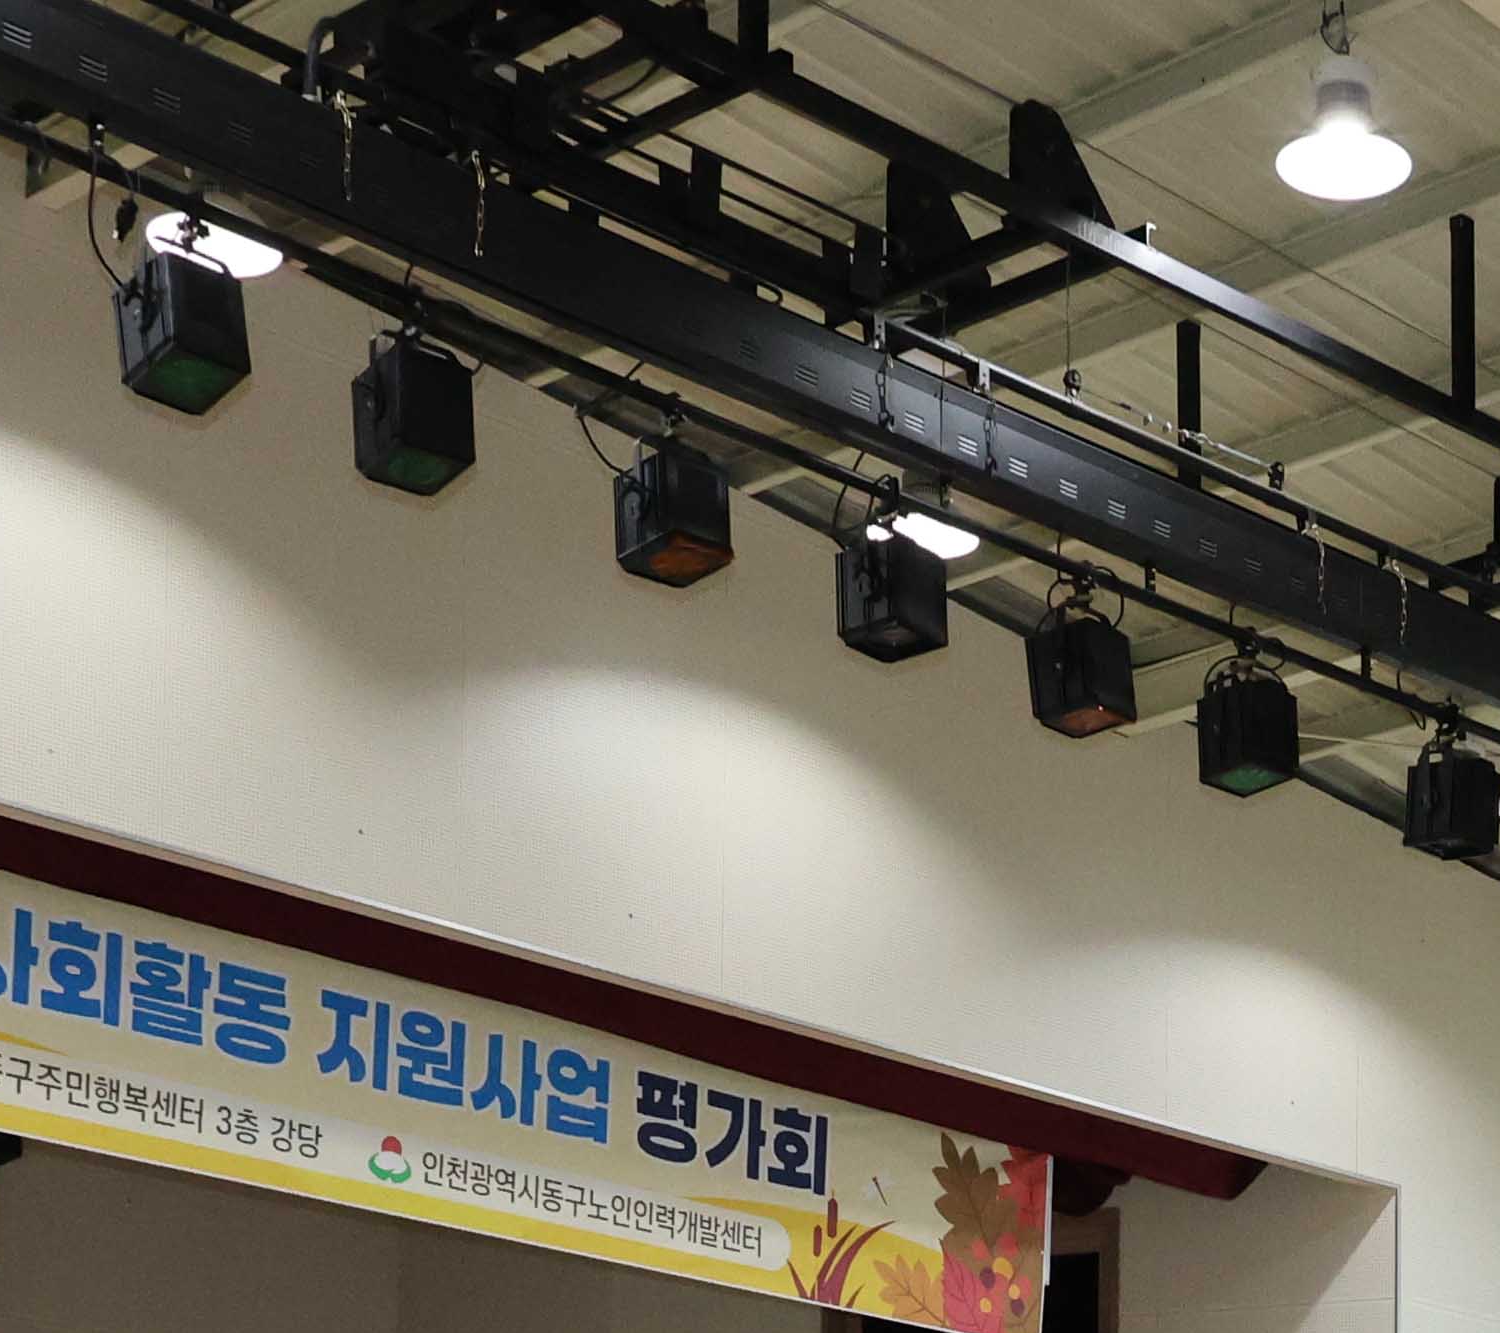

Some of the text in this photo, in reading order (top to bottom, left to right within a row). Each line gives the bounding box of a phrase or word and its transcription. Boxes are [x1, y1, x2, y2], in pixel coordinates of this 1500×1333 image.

[215, 1106, 260, 1145] 3층
[269, 1117, 324, 1159] 강당
[316, 988, 610, 1144] 지원사업
[636, 1071, 828, 1196] 평가회
[422, 1151, 763, 1258] 인천광역시동구노인인력개발센터
